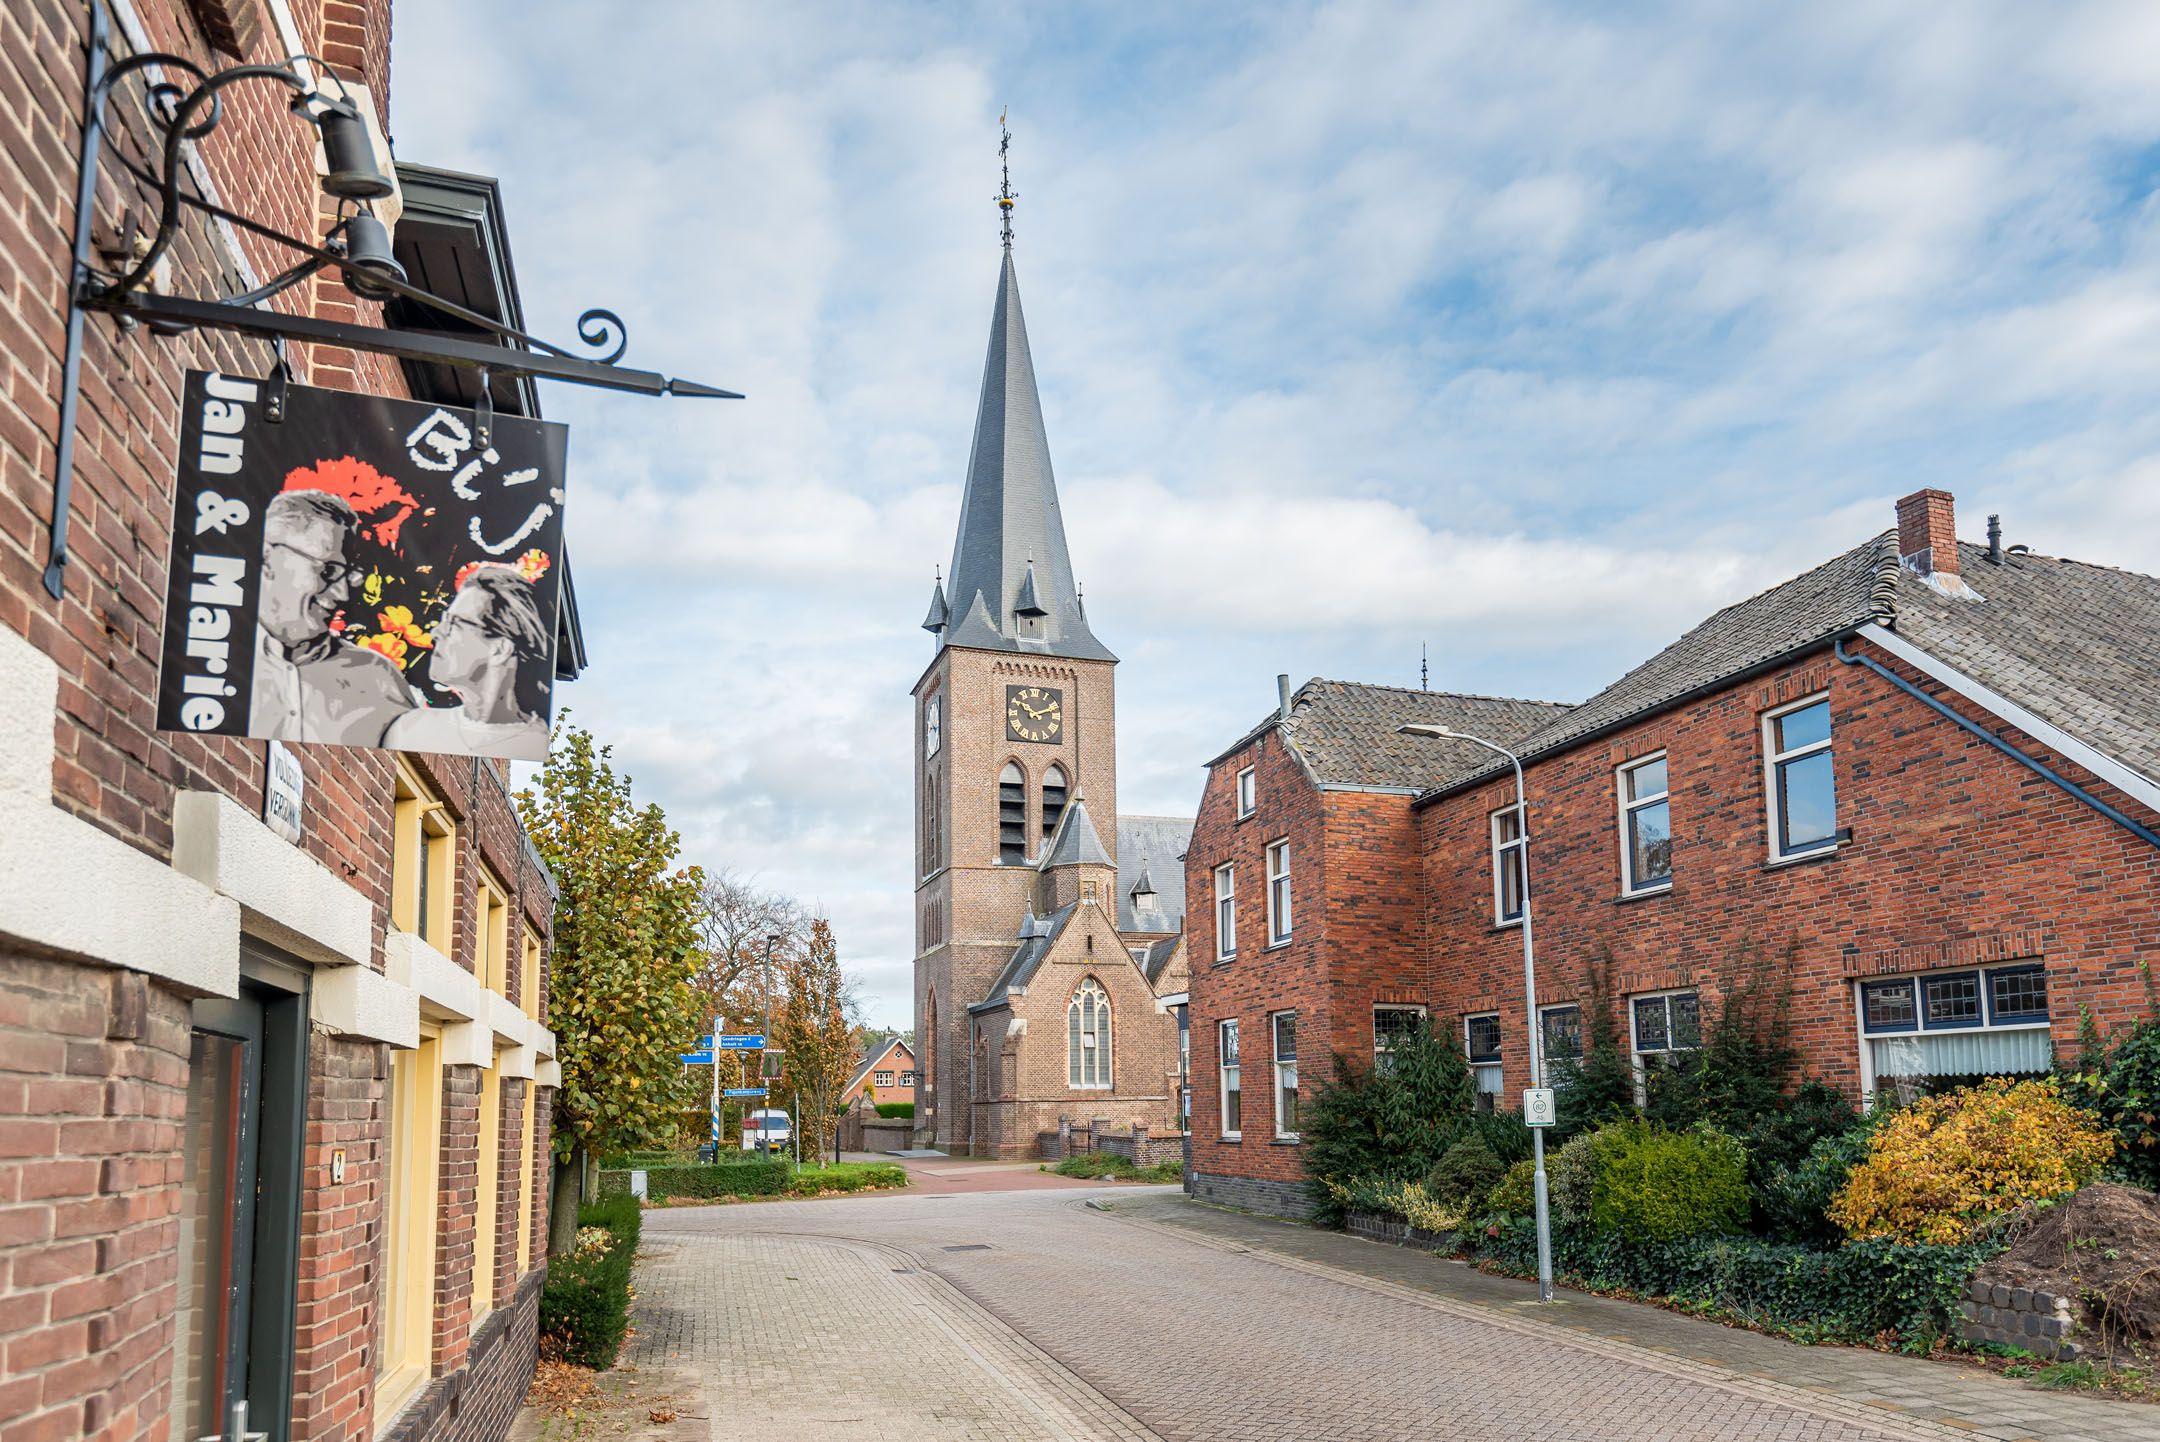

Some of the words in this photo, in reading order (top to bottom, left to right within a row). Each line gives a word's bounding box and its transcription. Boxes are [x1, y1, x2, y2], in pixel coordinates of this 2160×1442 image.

[200, 372, 258, 474] Jan
[405, 408, 565, 555] Bij
[195, 490, 250, 535] &
[180, 554, 246, 731] Marie
